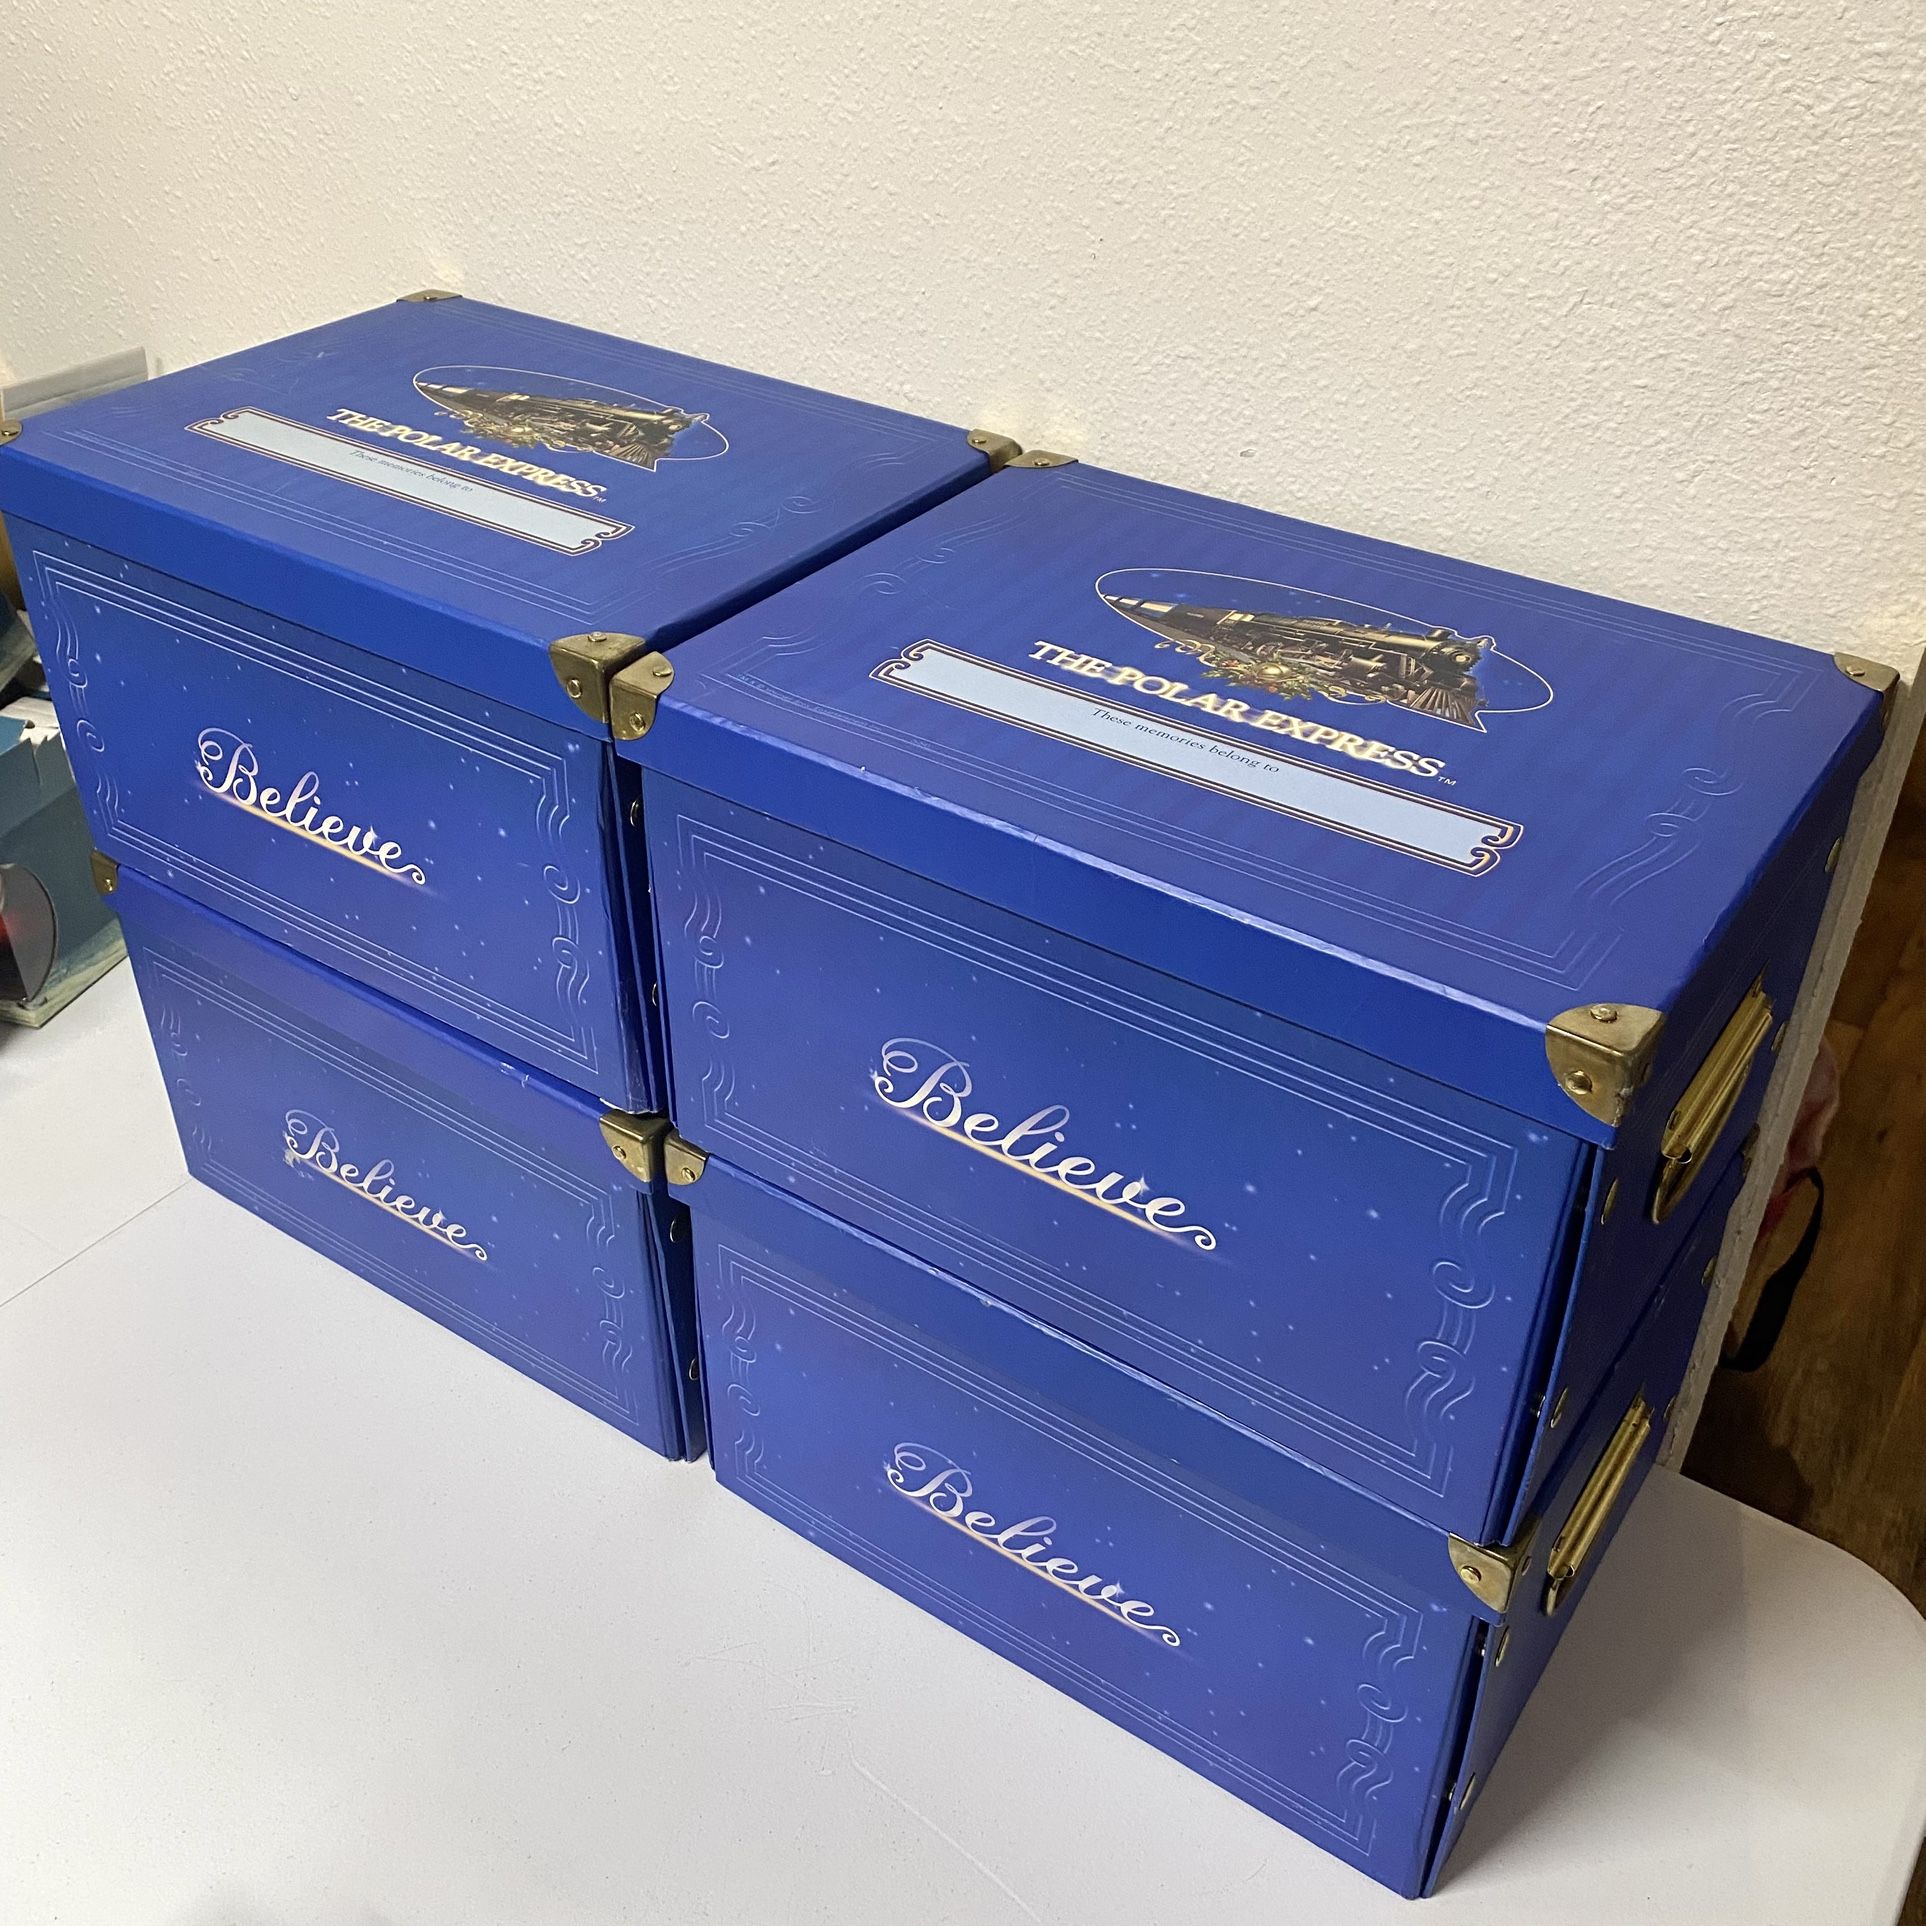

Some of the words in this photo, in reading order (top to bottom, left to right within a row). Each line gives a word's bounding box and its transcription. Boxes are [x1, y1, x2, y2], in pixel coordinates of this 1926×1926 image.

[326, 408, 392, 432] THE
[378, 424, 481, 463] POLAR
[471, 453, 607, 497] EXPRESS
[350, 449, 378, 462] These
[379, 459, 424, 477] memories
[425, 473, 460, 489] belong
[461, 484, 473, 492] to
[1028, 640, 1112, 678] THE
[1106, 666, 1250, 722] POLAR
[1248, 709, 1446, 777] EXPRESS
[1092, 707, 1132, 726] These
[1135, 722, 1205, 750] memories
[1208, 744, 1260, 771] belong
[1263, 763, 1280, 773] to
[197, 727, 426, 885] Believe
[284, 1109, 488, 1261] Believe
[874, 1038, 1216, 1251] Believe
[886, 1442, 1181, 1647] Believe
